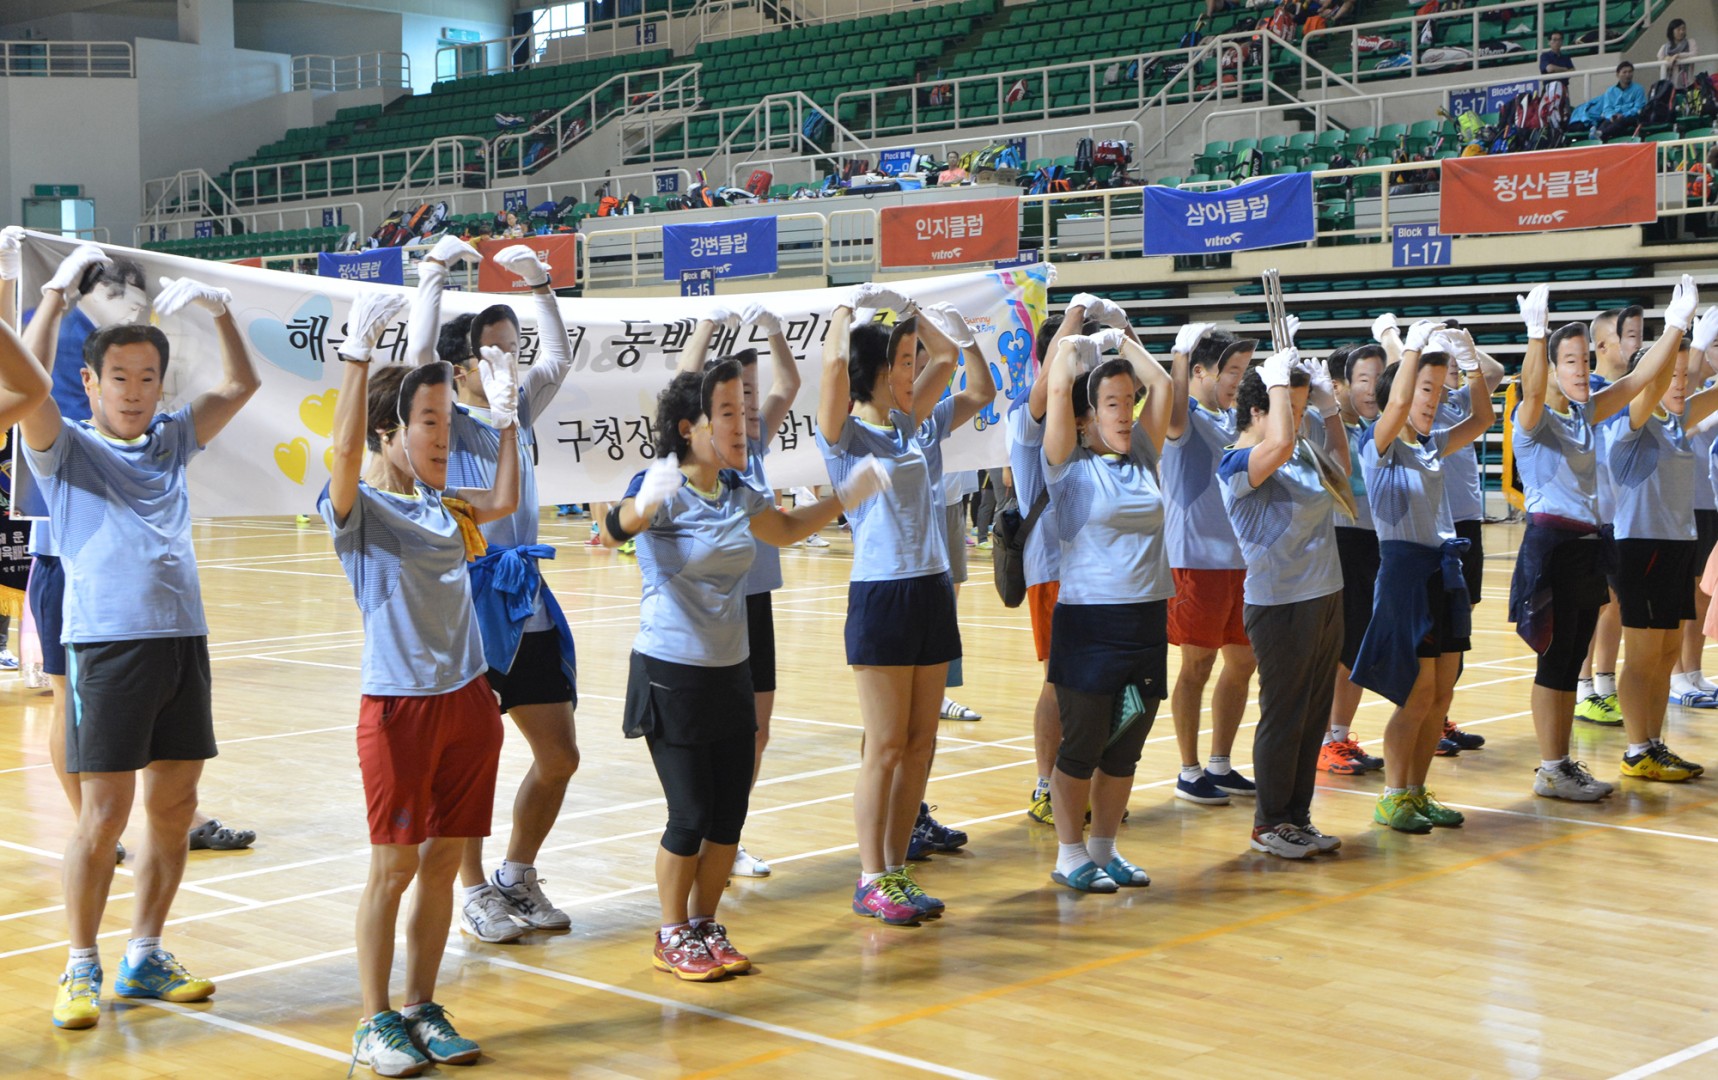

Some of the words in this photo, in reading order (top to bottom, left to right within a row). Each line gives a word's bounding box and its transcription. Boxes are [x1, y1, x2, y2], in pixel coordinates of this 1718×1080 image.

[1492, 86, 1513, 97] Block
[1454, 96, 1486, 117] 3-17
[1493, 168, 1599, 202] 청산클럽
[1185, 194, 1270, 227] 삼어클럽
[1518, 213, 1552, 226] vitro
[915, 213, 984, 241] 인지클럽
[1398, 226, 1422, 238] Block
[690, 233, 748, 258] 강변클럽
[1205, 234, 1232, 248] vitro
[931, 248, 954, 260] vitro
[1402, 242, 1443, 265] 1-17
[338, 261, 381, 279] 장산클럽
